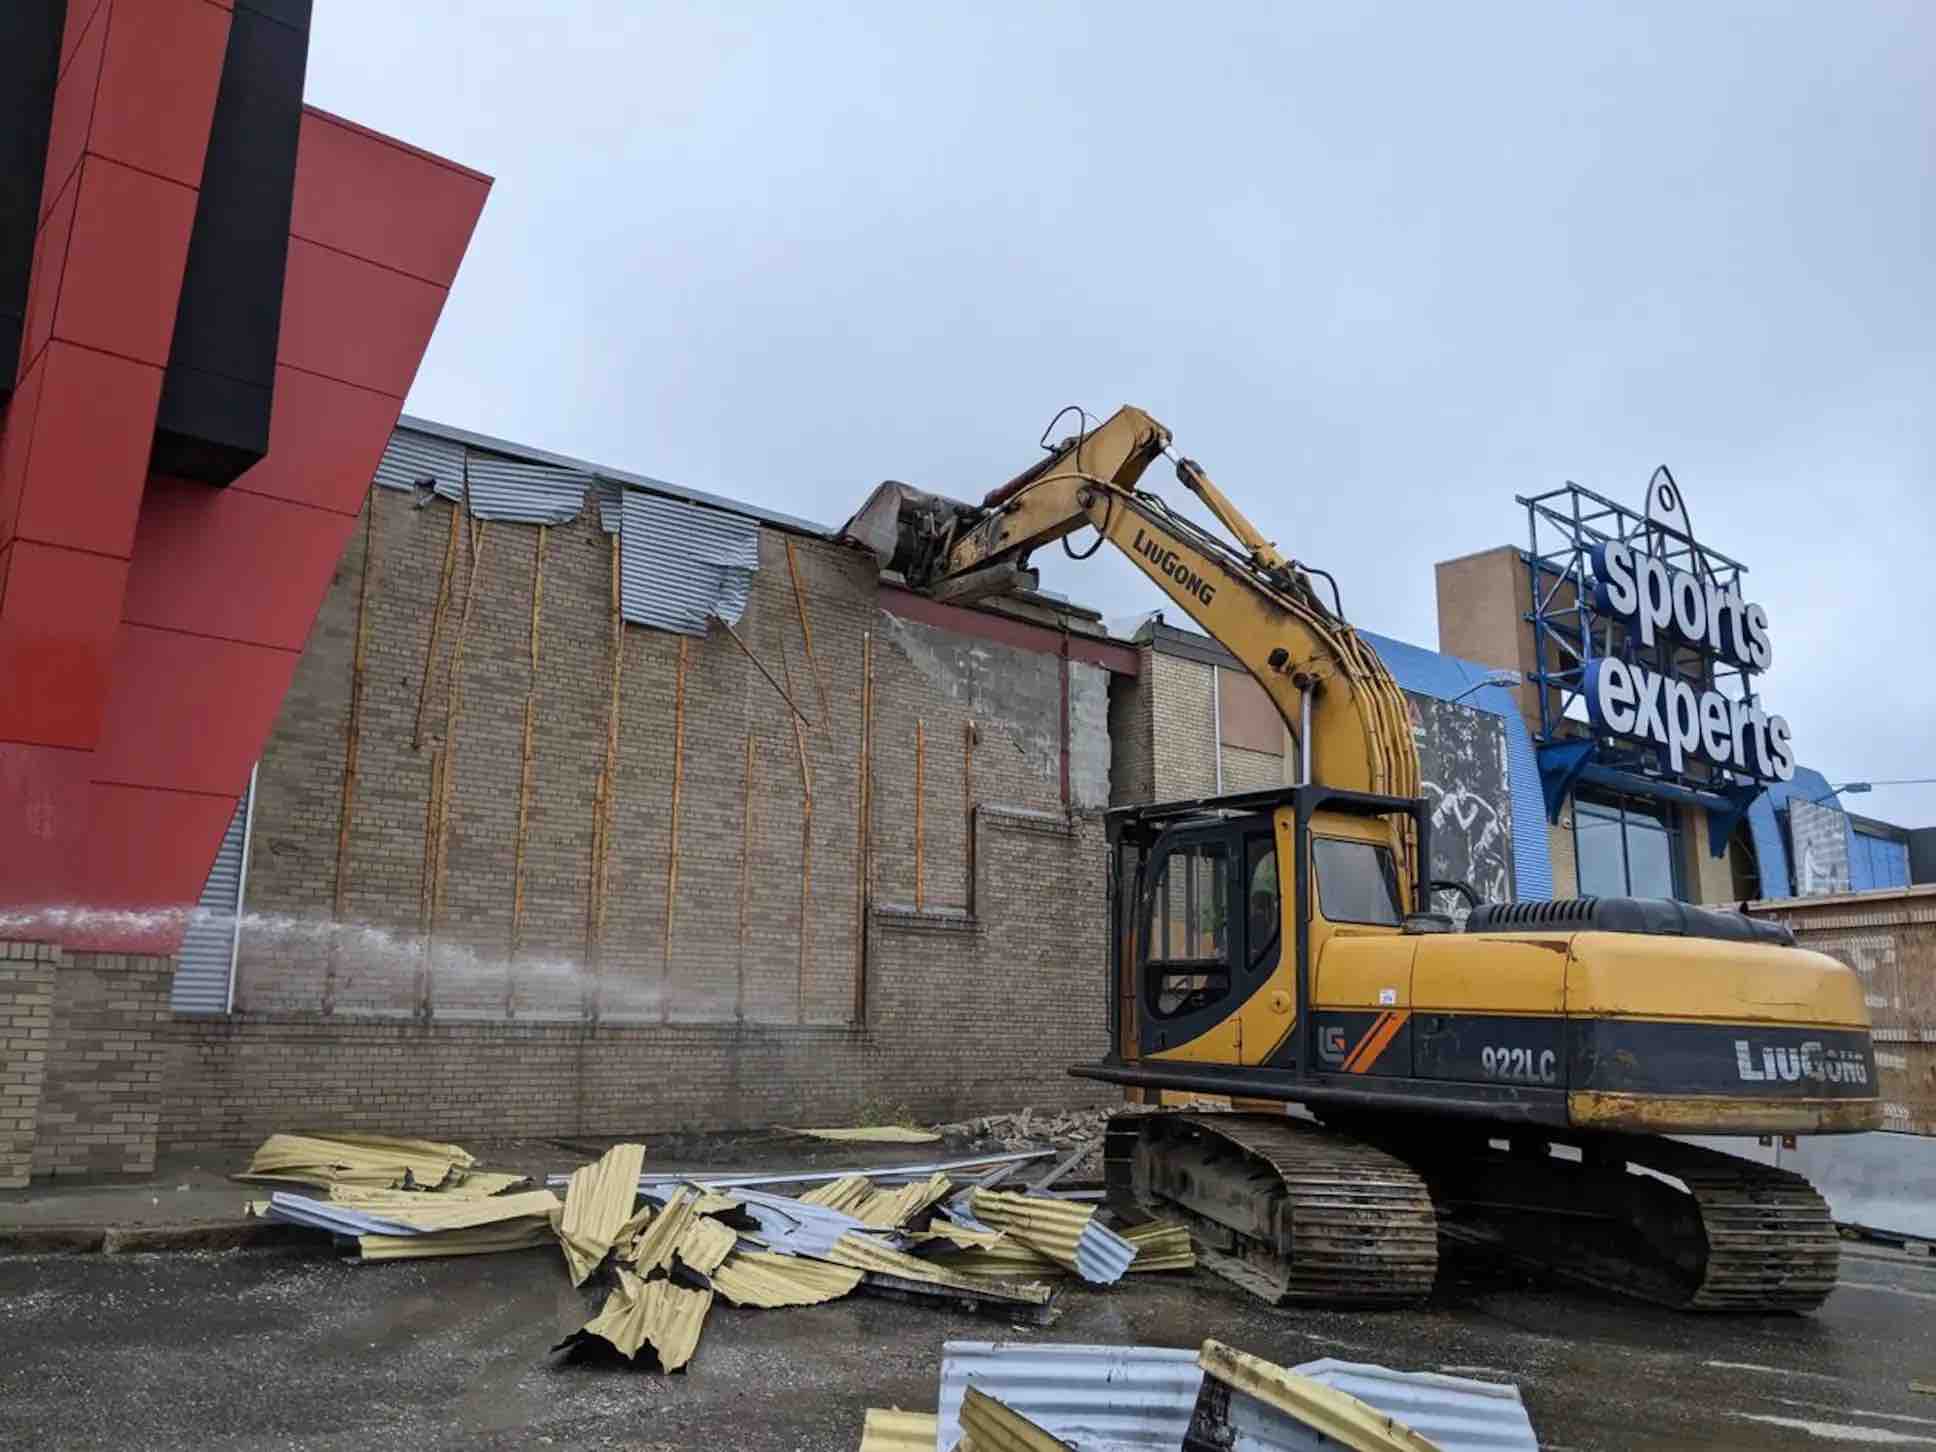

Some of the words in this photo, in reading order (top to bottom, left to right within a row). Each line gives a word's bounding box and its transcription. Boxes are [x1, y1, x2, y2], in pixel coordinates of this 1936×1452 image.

[1603, 539, 1772, 669] sports
[1597, 657, 1794, 782] experts
[1482, 1046, 1556, 1084] 922LC
